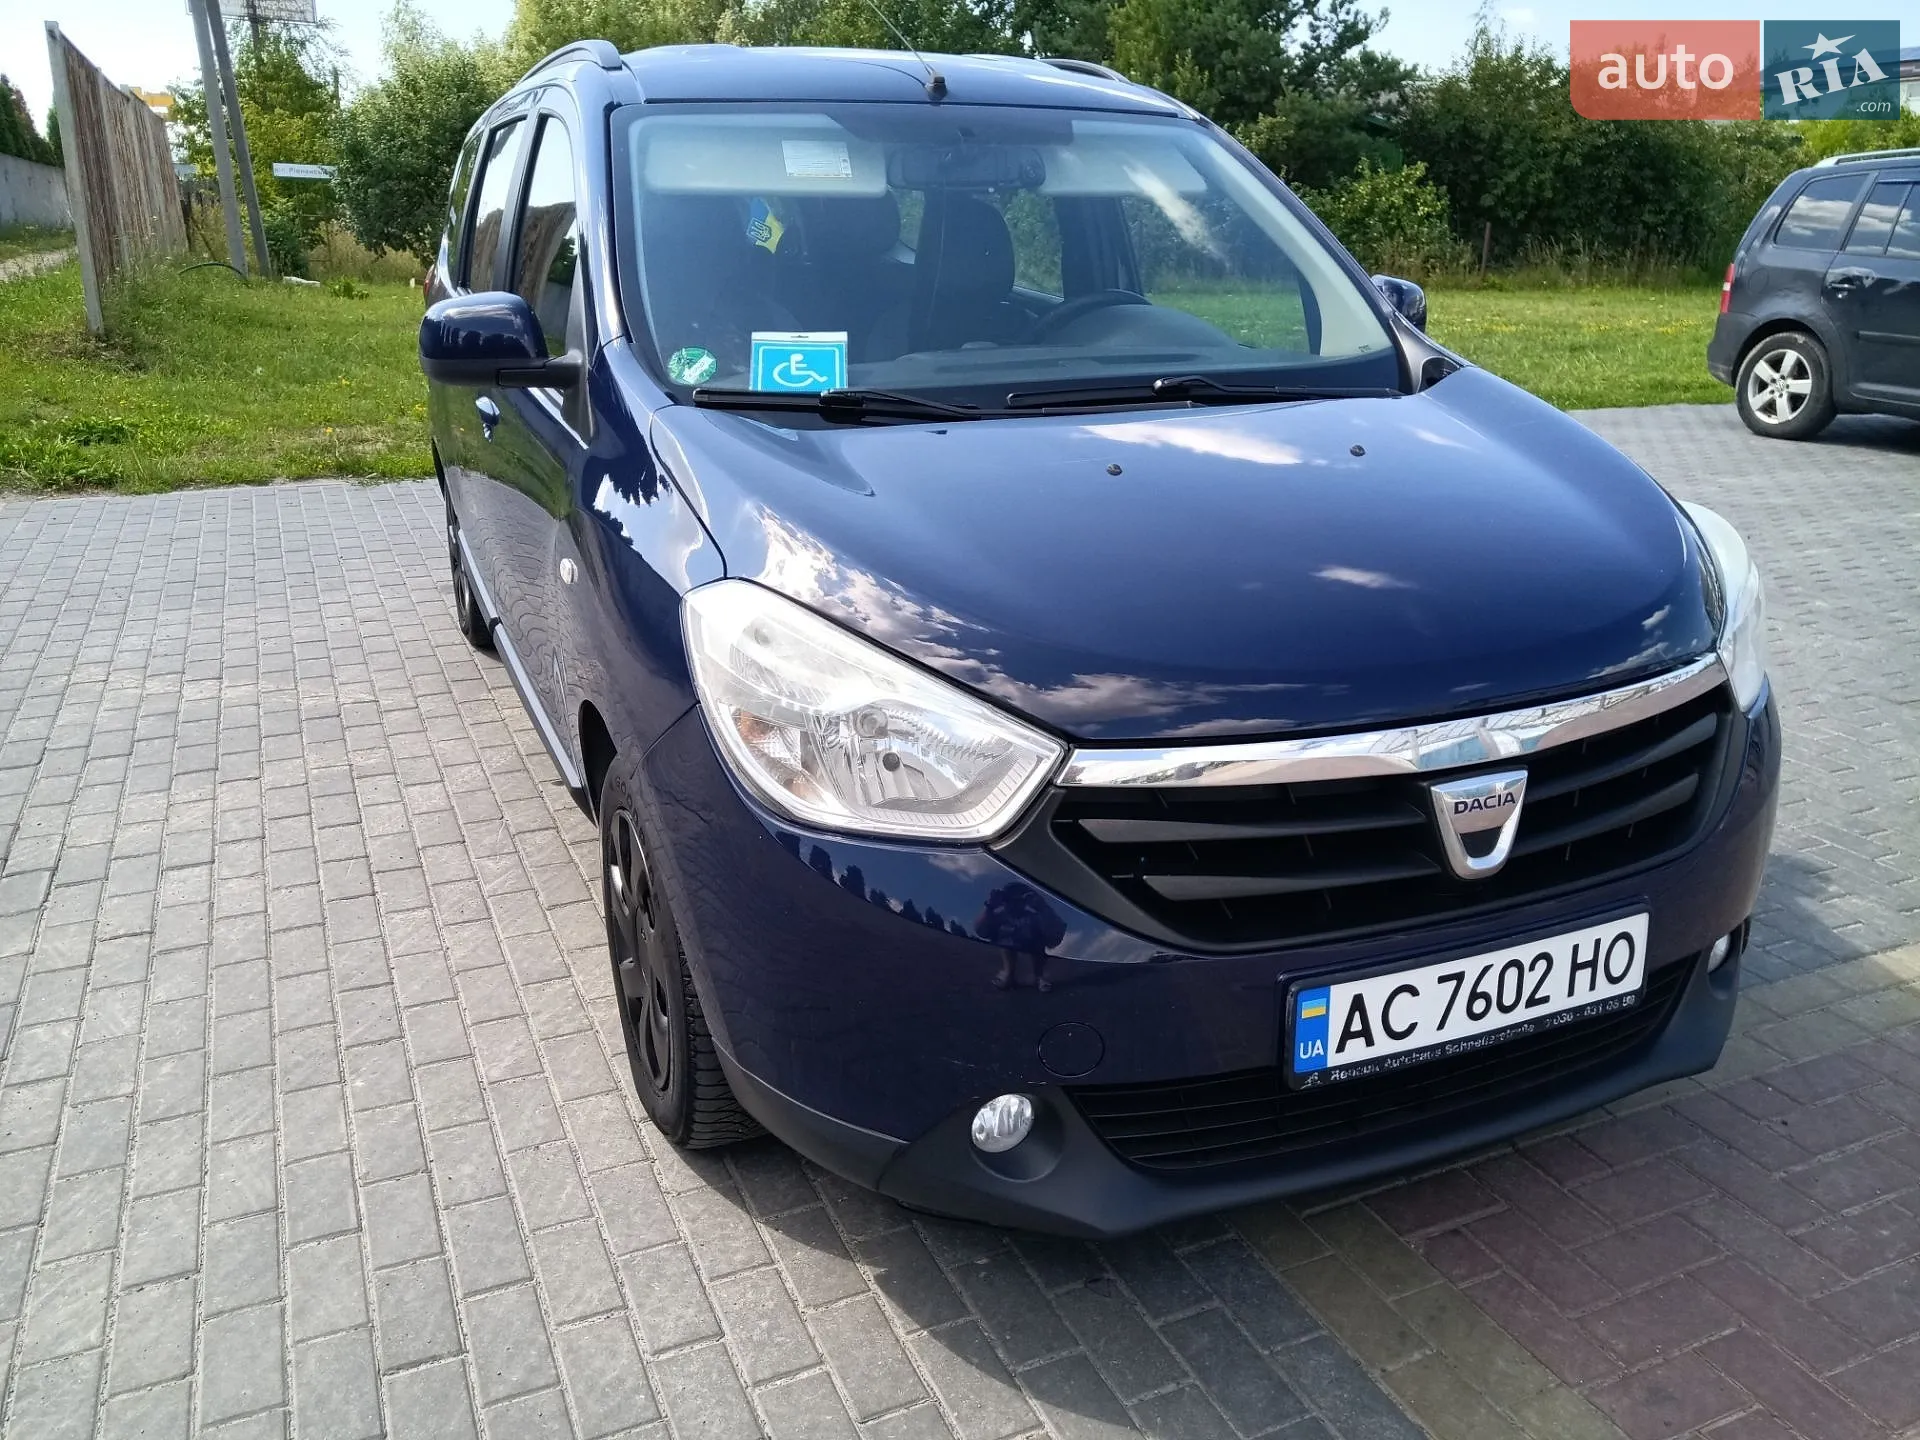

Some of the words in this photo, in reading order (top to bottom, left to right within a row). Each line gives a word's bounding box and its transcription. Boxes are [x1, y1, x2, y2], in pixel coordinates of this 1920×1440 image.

[1453, 792, 1516, 815] DACIA
[1334, 984, 1422, 1054] AC
[1435, 951, 1554, 1033] 7602
[1566, 930, 1636, 998] HO
[1299, 1040, 1325, 1060] UA
